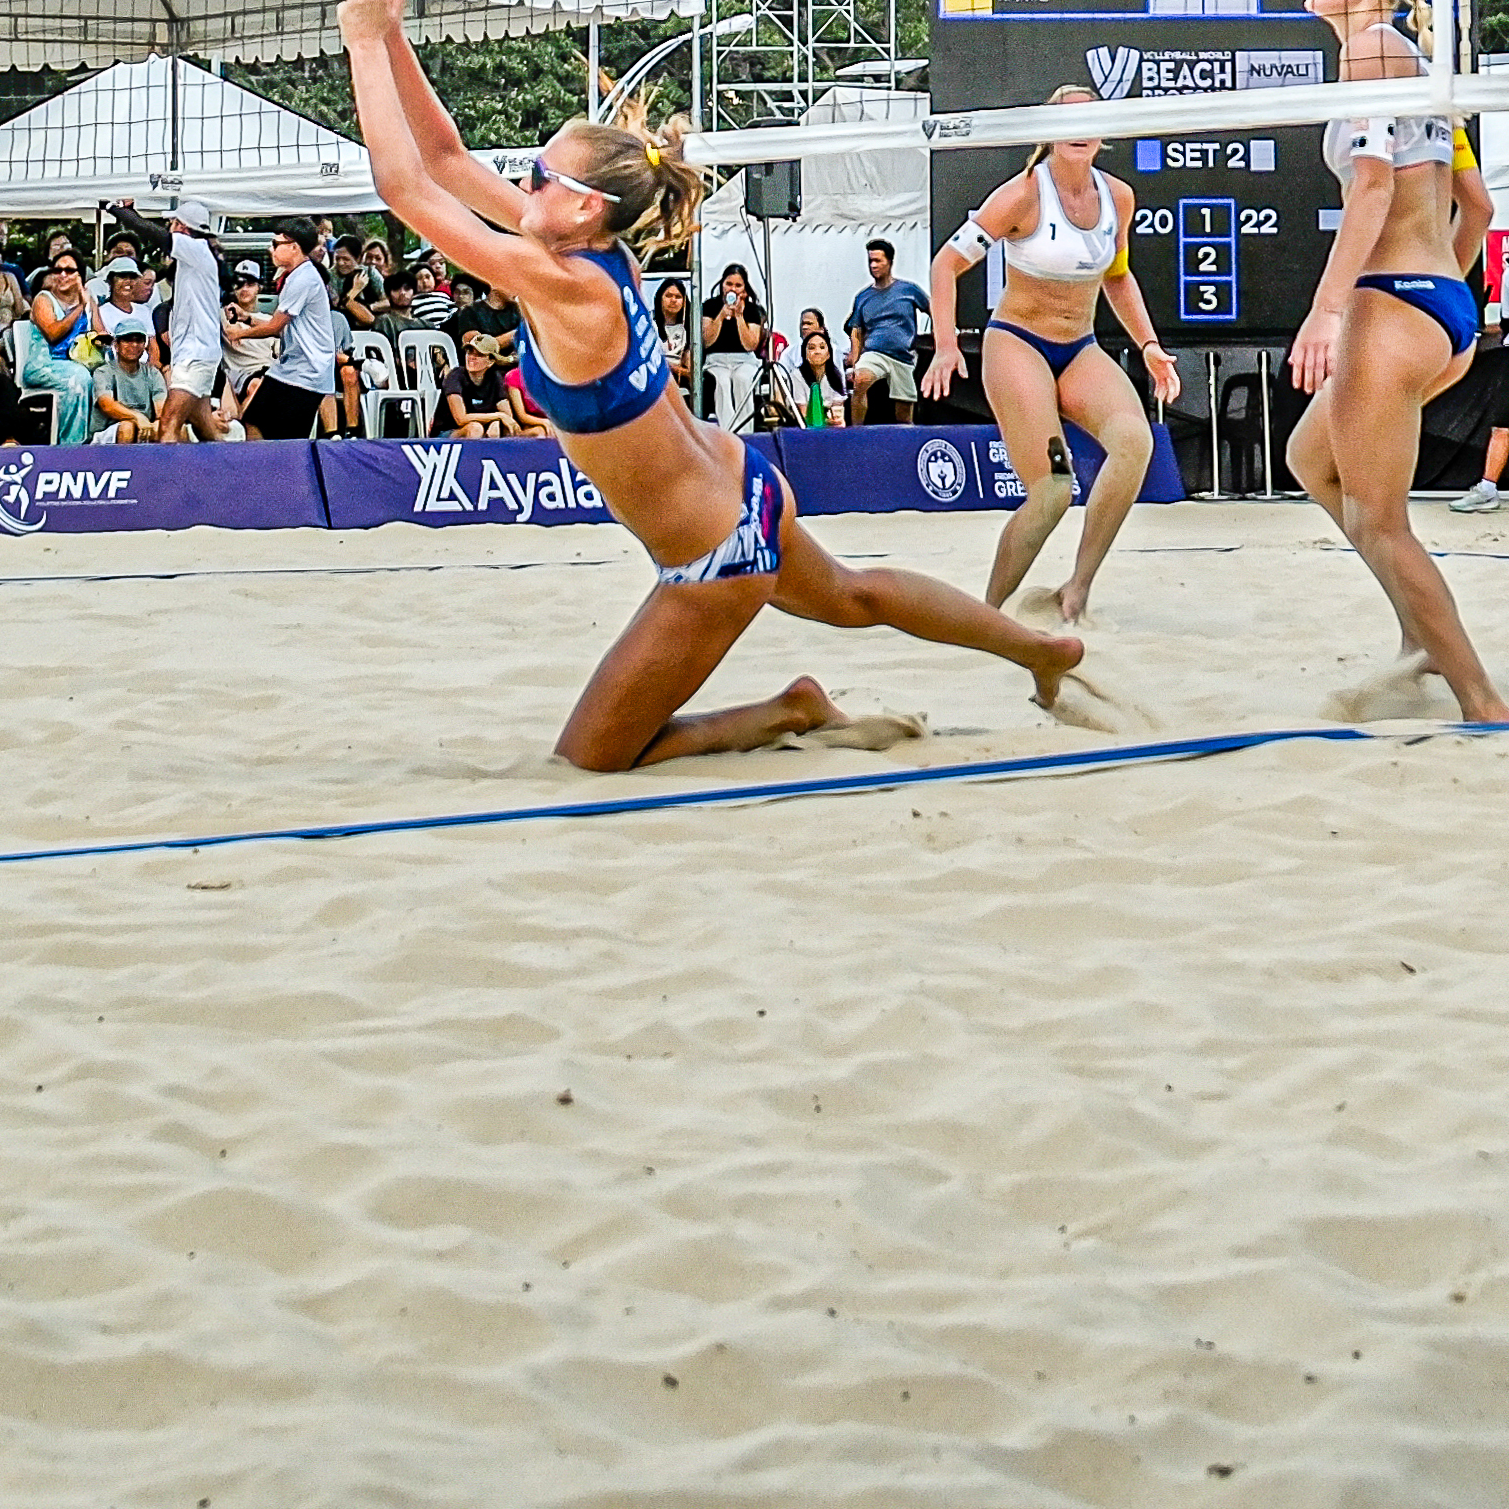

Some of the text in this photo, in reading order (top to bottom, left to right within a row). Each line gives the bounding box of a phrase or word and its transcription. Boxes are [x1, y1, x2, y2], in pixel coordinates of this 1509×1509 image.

[1141, 61, 1232, 88] BEACH
[1166, 141, 1246, 169] SET 2
[1135, 208, 1278, 234] 20 1 22
[1197, 246, 1218, 272] 2
[1198, 285, 1218, 311] 3
[34, 470, 132, 500] PNVF
